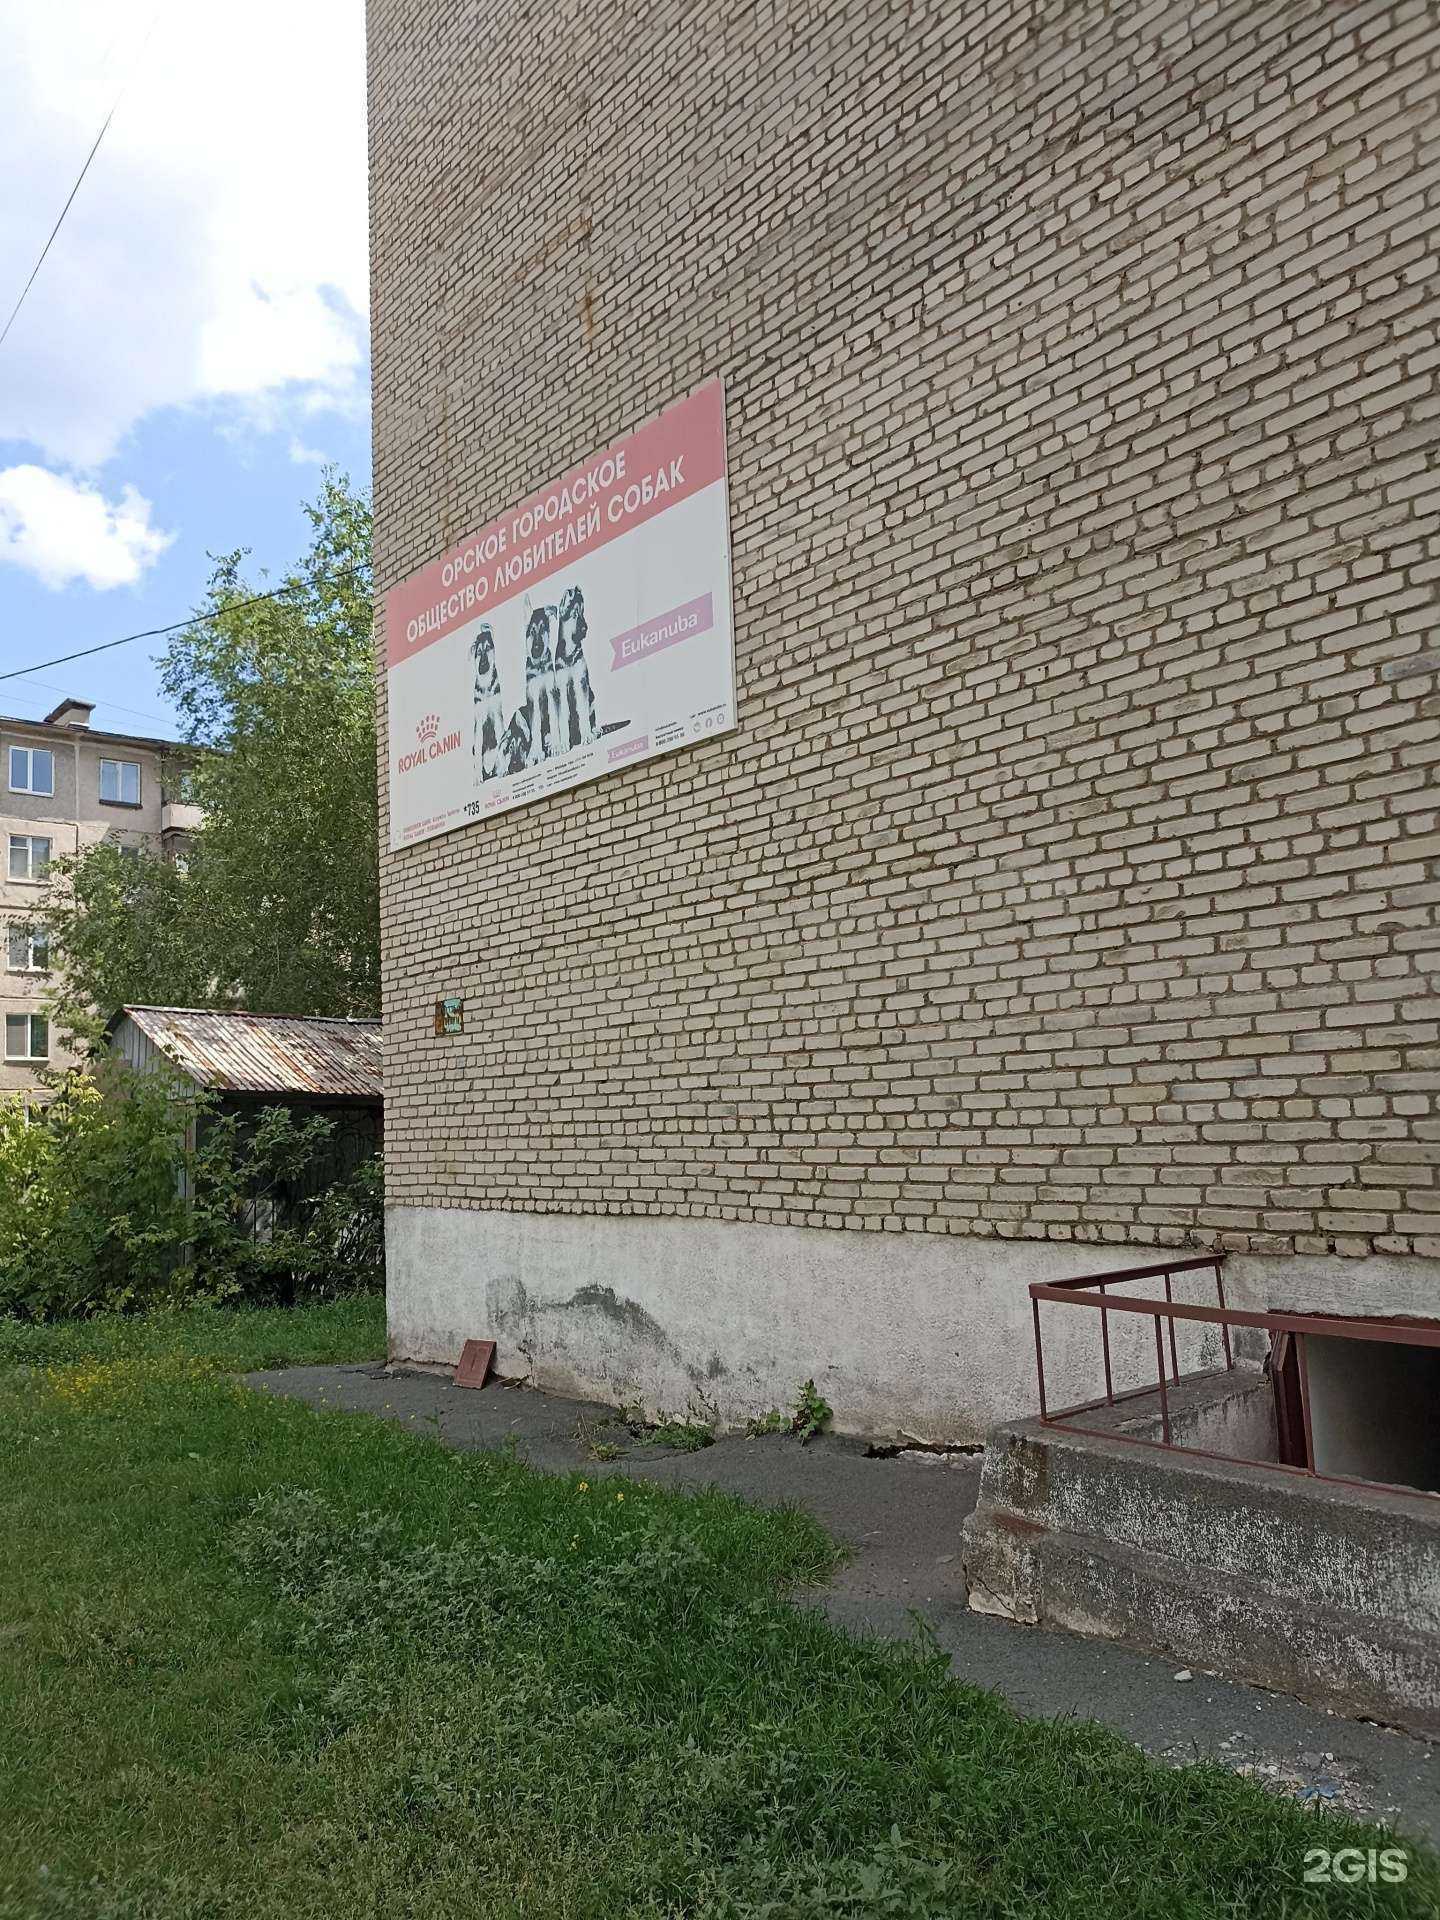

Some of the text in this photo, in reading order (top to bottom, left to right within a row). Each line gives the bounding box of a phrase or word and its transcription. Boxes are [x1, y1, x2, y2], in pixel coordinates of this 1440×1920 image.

[407, 455, 686, 642] ОБЩЕСТВО ЛЮБИТЕЛЕЙ СОБАК
[442, 451, 626, 587] ОРСКОЕ ГОРОДСКОЕ
[622, 610, 698, 658] Eukanuba
[399, 731, 461, 775] ROYAL CANIN
